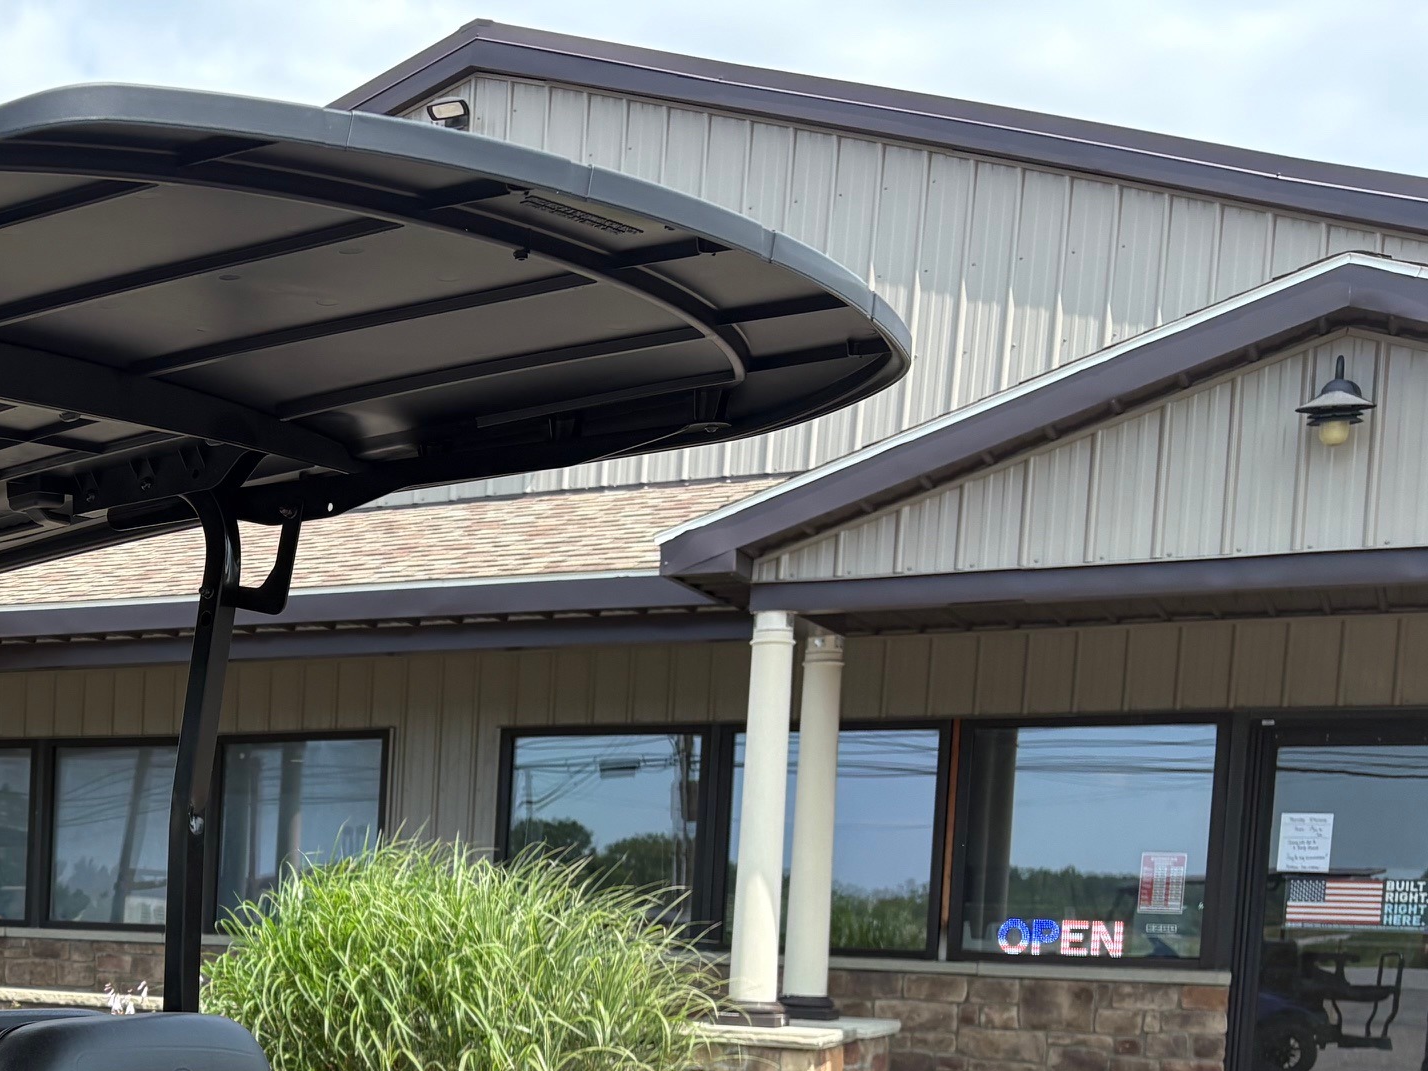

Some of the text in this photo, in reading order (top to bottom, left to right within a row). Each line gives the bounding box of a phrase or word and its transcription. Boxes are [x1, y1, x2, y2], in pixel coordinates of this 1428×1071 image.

[1386, 880, 1427, 892] BUILT
[1384, 903, 1428, 915] RIGHT
[1383, 914, 1426, 926] HERE.
[997, 918, 1124, 958] OPEN
